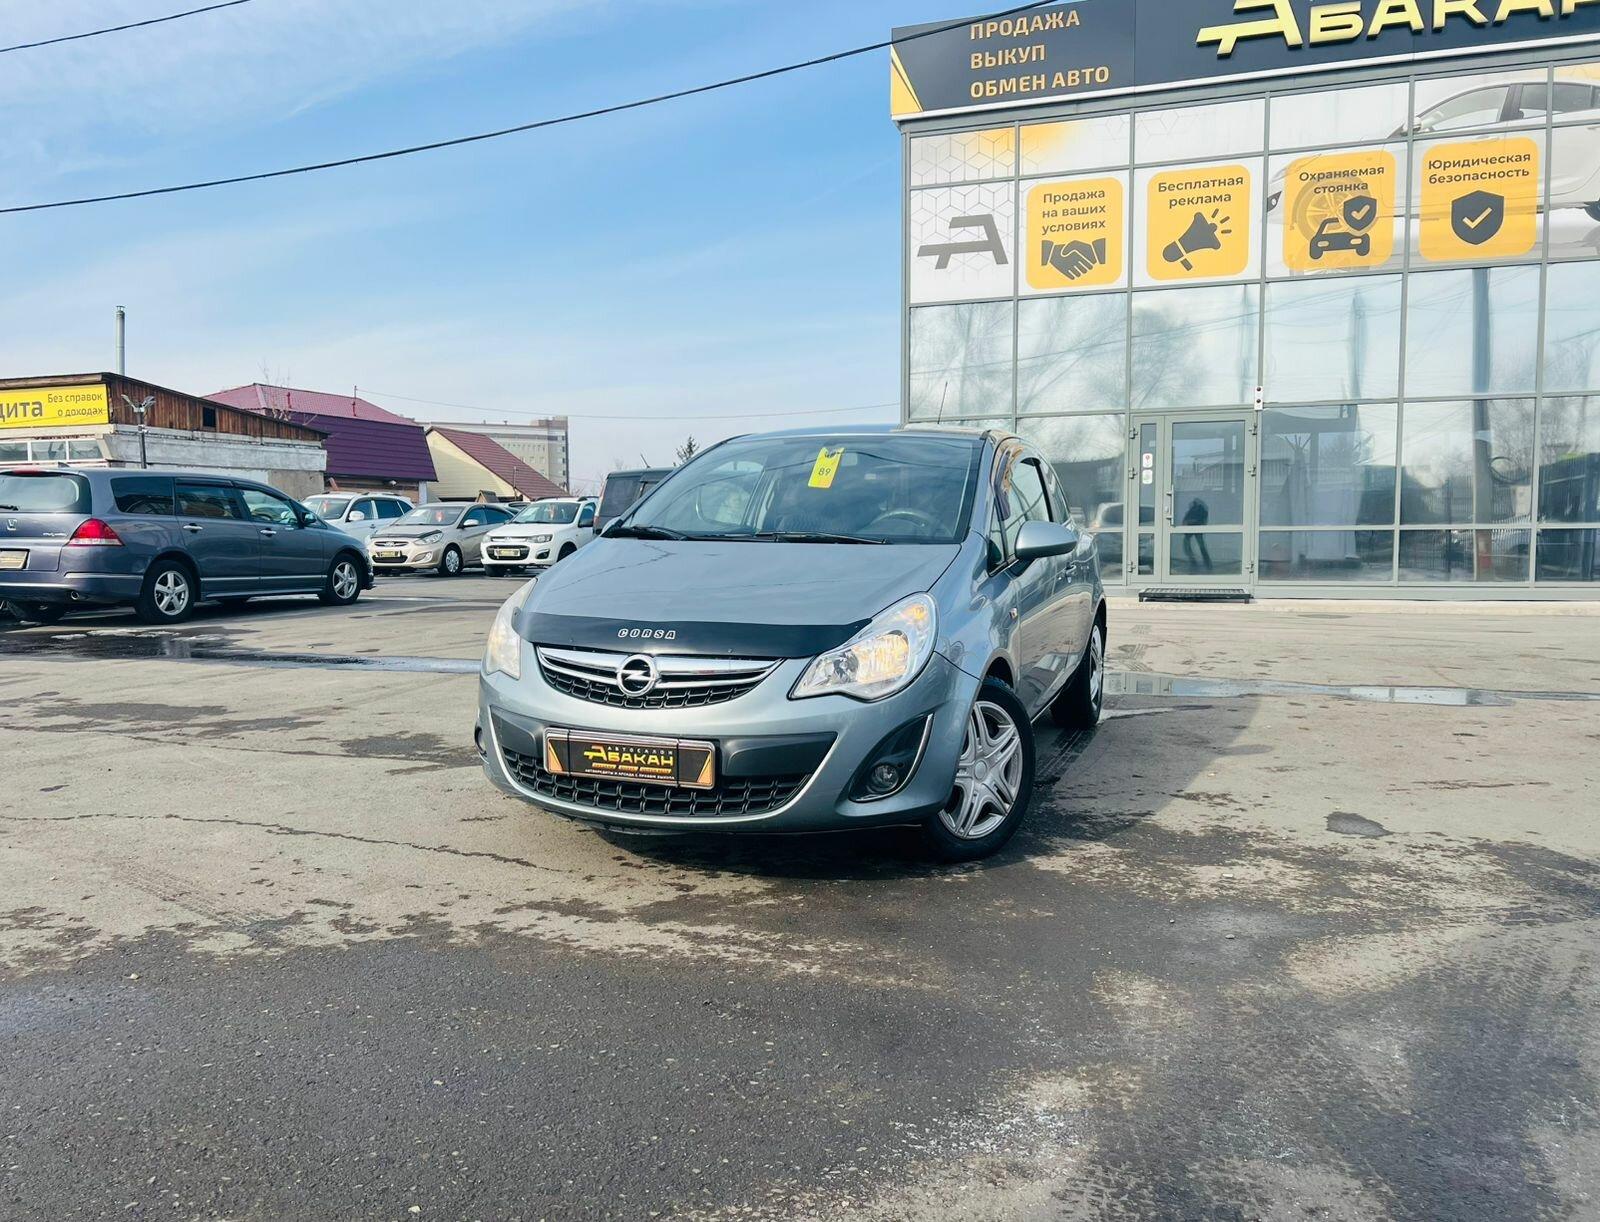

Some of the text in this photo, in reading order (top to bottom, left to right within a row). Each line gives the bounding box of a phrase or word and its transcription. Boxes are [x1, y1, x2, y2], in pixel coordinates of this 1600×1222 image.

[970, 10, 1080, 40] ПРОДАЖА
[970, 44, 1046, 70] ВЫКУП
[970, 66, 1110, 98] ОБМЕН АВТО
[1428, 153, 1531, 171] Юридическая
[1299, 166, 1385, 183] Охраняемая
[1428, 168, 1530, 184] безопасность
[1158, 176, 1244, 193] Бесплатная
[1313, 182, 1369, 195] стоянка
[1043, 189, 1105, 205] Продажа
[1169, 193, 1232, 209] реклама
[1042, 204, 1106, 219] на ваших
[1042, 219, 1106, 236] условиях
[47, 393, 103, 404] Без справок
[65, 407, 103, 417] доходах
[819, 467, 831, 476] 89
[617, 628, 676, 640] CORSA
[584, 744, 674, 766] АБАКАН
